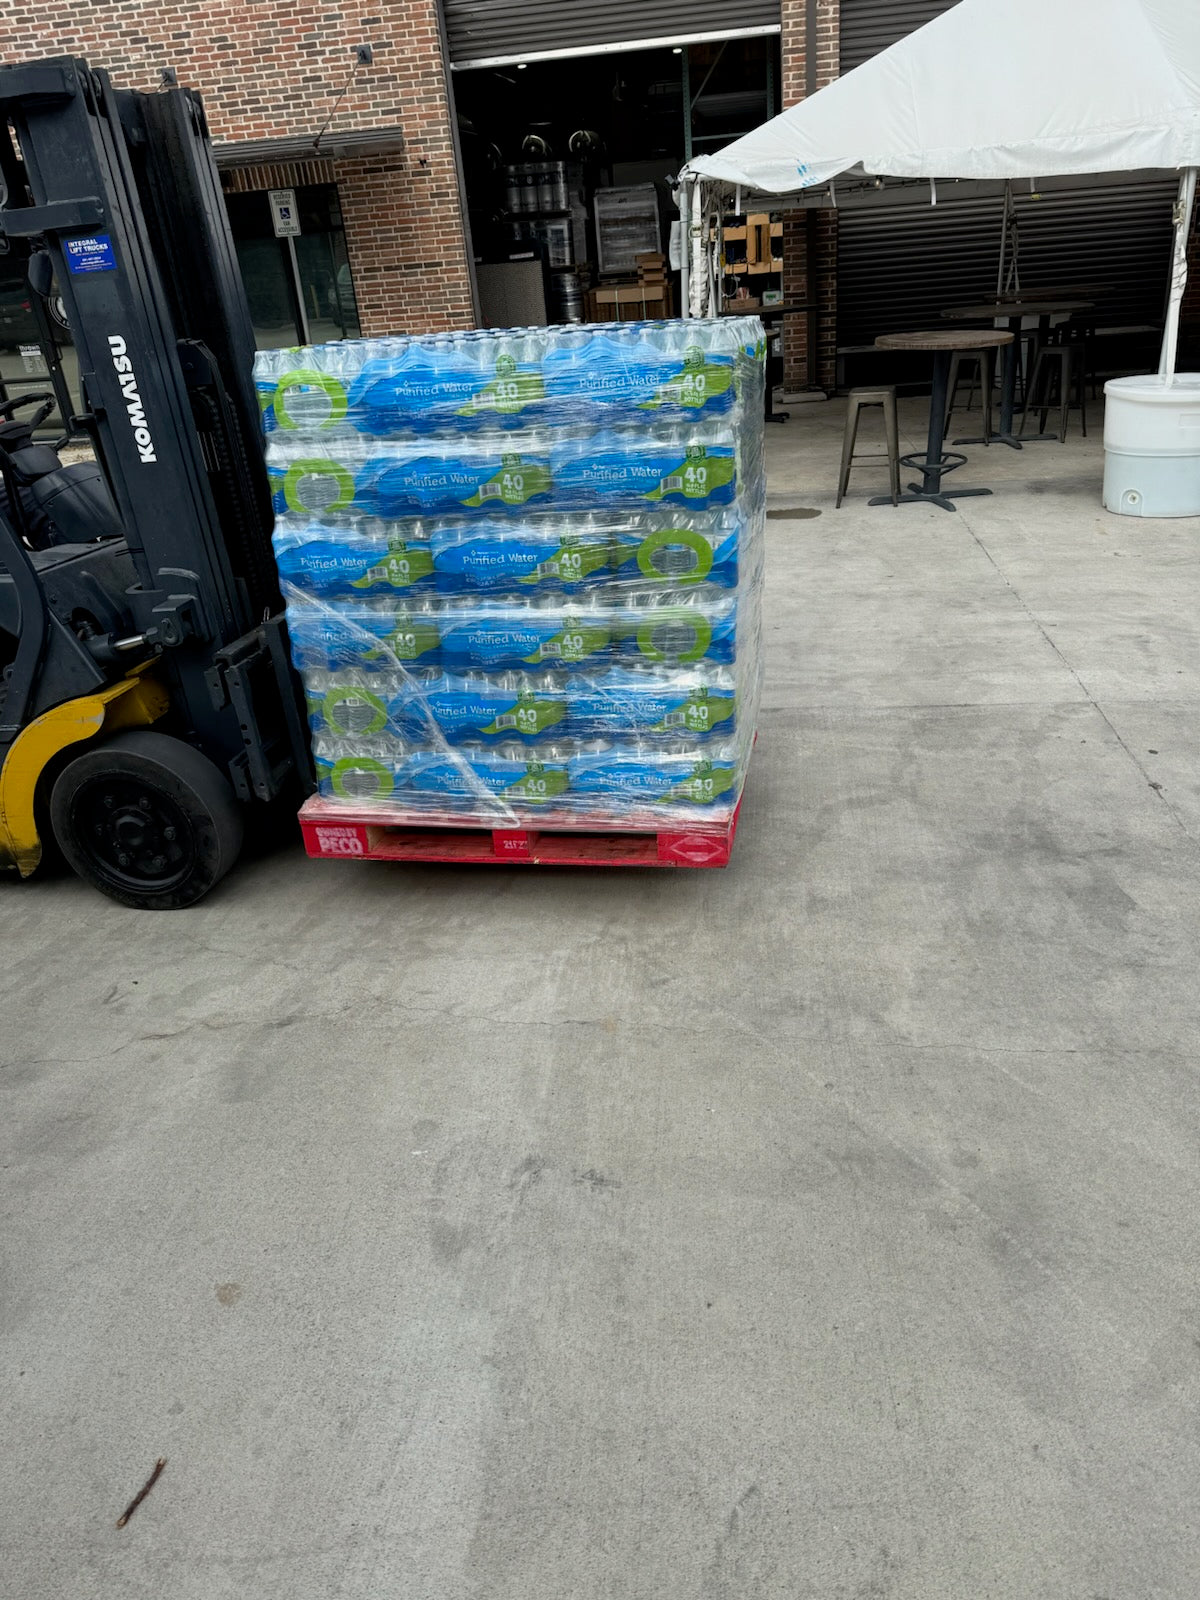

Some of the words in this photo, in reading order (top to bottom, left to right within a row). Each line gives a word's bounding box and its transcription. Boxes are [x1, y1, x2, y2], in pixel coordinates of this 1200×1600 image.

[68, 239, 98, 248] INTEGRAL
[70, 247, 83, 255] LIFT
[84, 243, 109, 253] TRUCKS
[395, 384, 439, 397] Purified
[442, 382, 473, 393] Water
[579, 377, 626, 389] Purified
[629, 375, 661, 386] Water
[684, 374, 706, 391] 40
[107, 335, 158, 464] KOMATSU
[404, 474, 447, 487] Purified
[450, 472, 480, 485] Water
[583, 468, 627, 480] Purified
[631, 466, 663, 478] Water
[685, 466, 707, 484] 40
[502, 474, 524, 490] 40
[300, 556, 338, 569] Purified
[340, 557, 368, 568] Water
[389, 558, 410, 574] 40
[463, 555, 505, 565] Purified
[508, 553, 538, 563] Water
[560, 552, 582, 569] 40
[397, 633, 416, 648] 40
[468, 634, 509, 645] Purified
[512, 633, 540, 644] Water
[563, 634, 584, 650] 40
[470, 704, 497, 716] Water
[518, 708, 537, 723] 40
[688, 704, 709, 720] 40
[527, 779, 546, 793] 40
[318, 836, 364, 855] PECO
